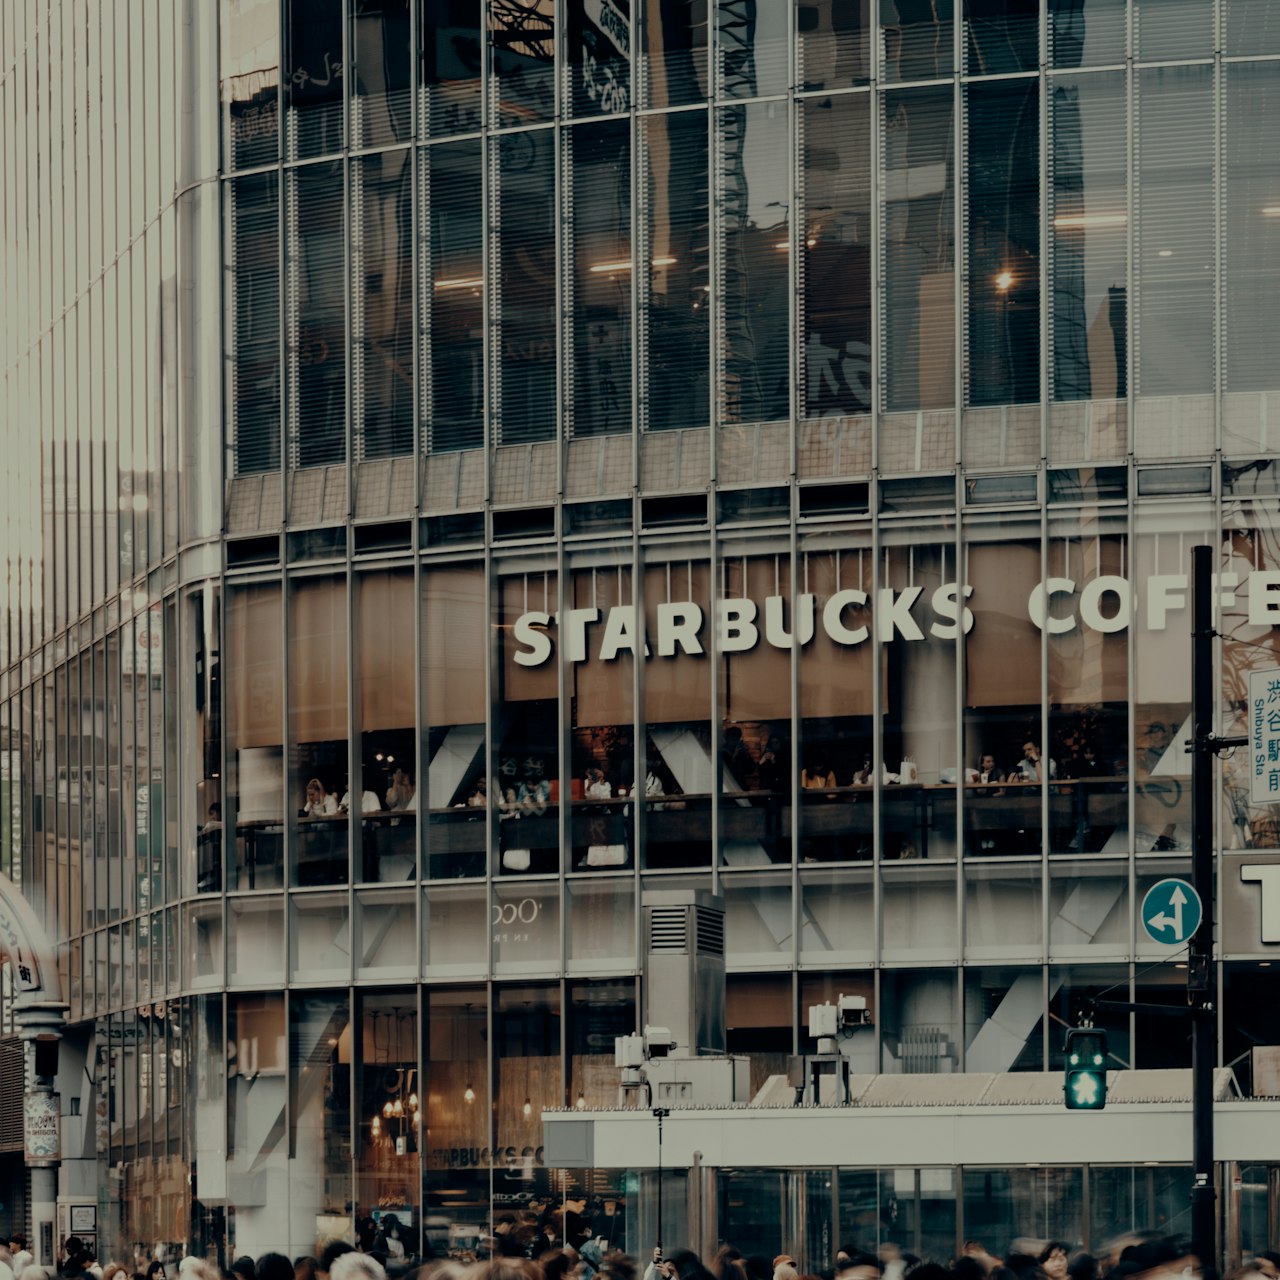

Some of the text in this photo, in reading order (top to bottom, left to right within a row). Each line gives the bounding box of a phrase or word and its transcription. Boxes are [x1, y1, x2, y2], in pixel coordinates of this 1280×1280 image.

[512, 583, 975, 668] STARBUCKS
[1253, 698, 1266, 780] Shibuya Sta.
